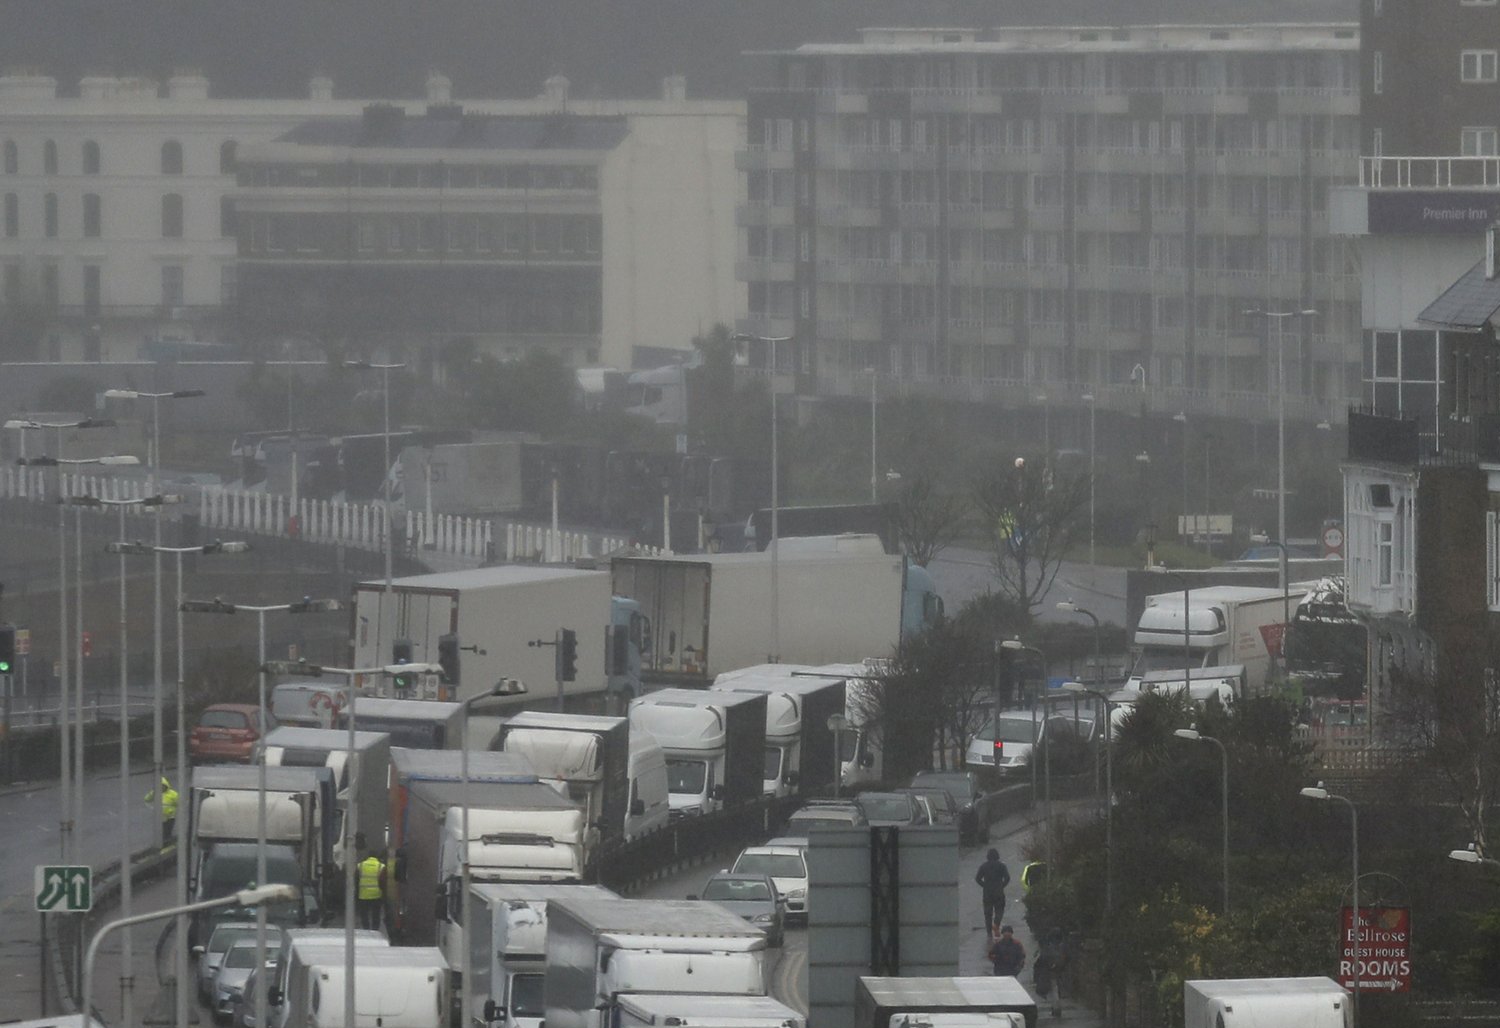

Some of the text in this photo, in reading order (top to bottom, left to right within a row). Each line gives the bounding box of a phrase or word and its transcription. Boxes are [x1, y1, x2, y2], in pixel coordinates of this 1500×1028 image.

[1423, 207, 1488, 219] Premier Inn
[1344, 948, 1405, 957] GUEST HOUSE
[1340, 961, 1410, 976] ROOMS
